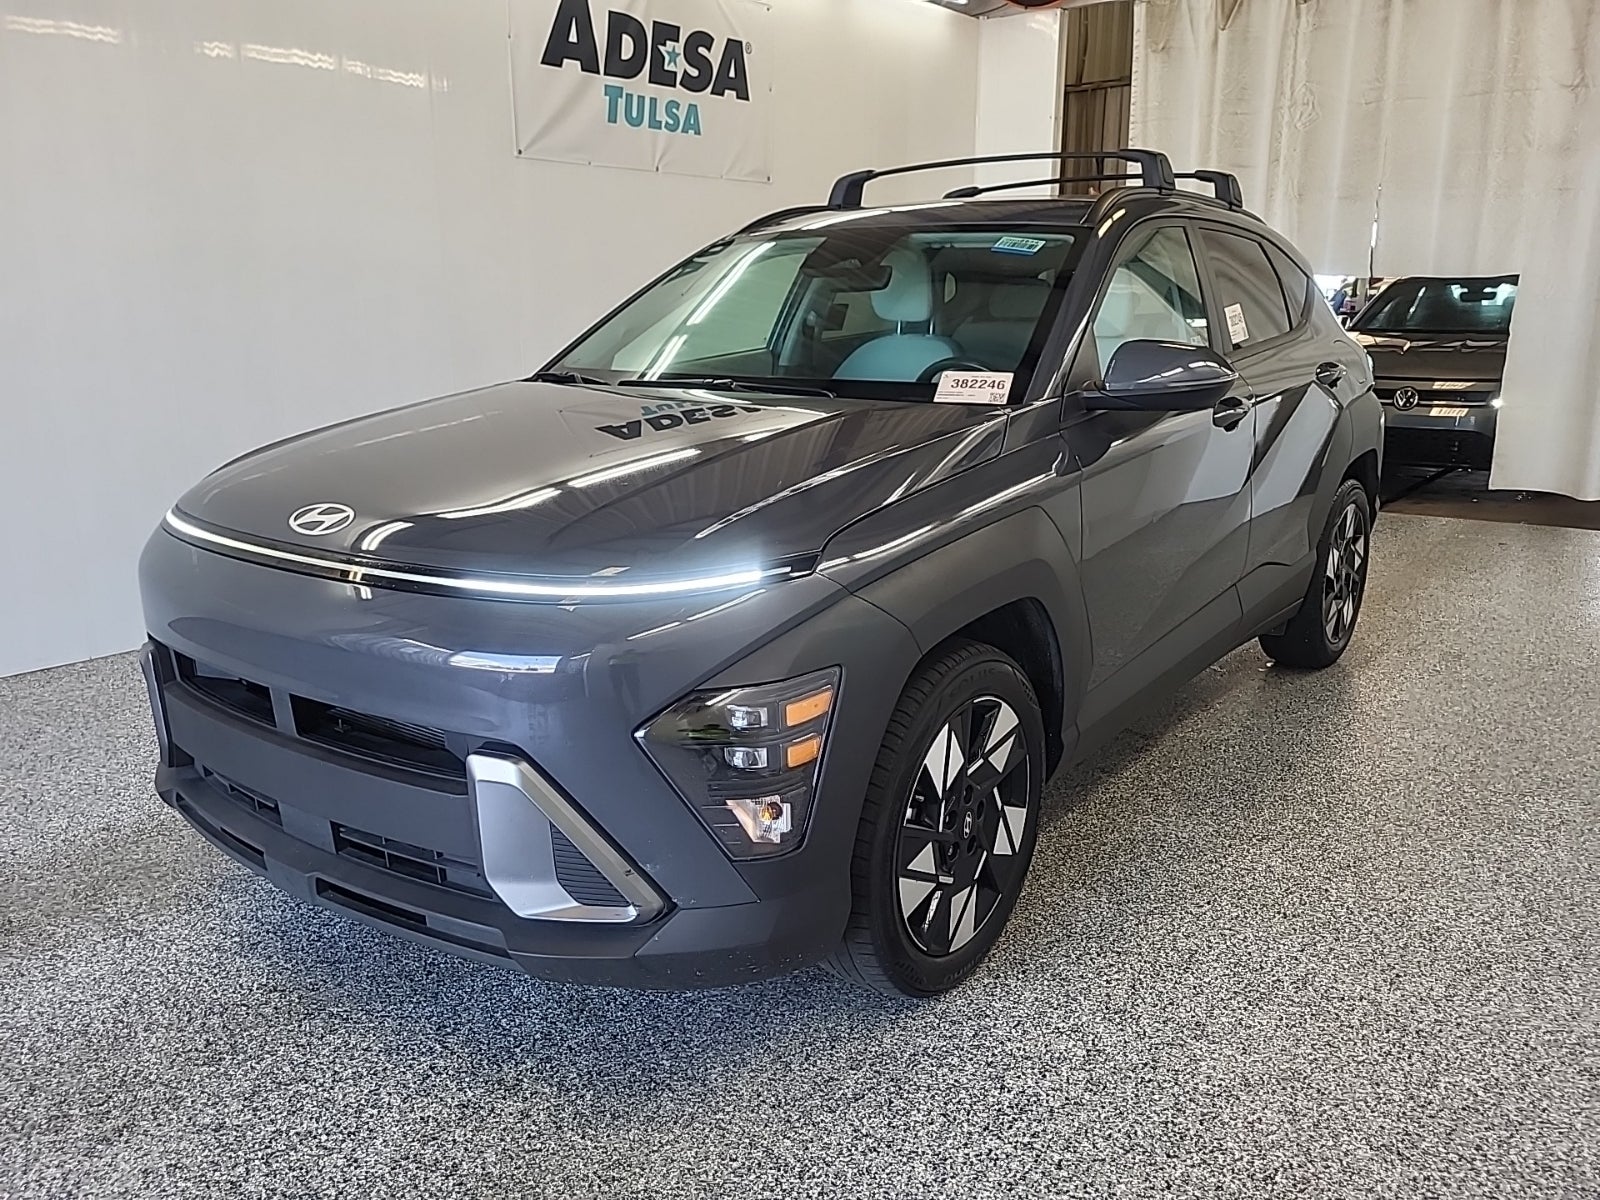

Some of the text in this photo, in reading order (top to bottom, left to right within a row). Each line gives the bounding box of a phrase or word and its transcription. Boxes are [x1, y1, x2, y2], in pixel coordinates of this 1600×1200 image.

[541, 0, 750, 101] ADESA
[604, 84, 701, 135] TULSA
[951, 379, 1006, 390] 382246
